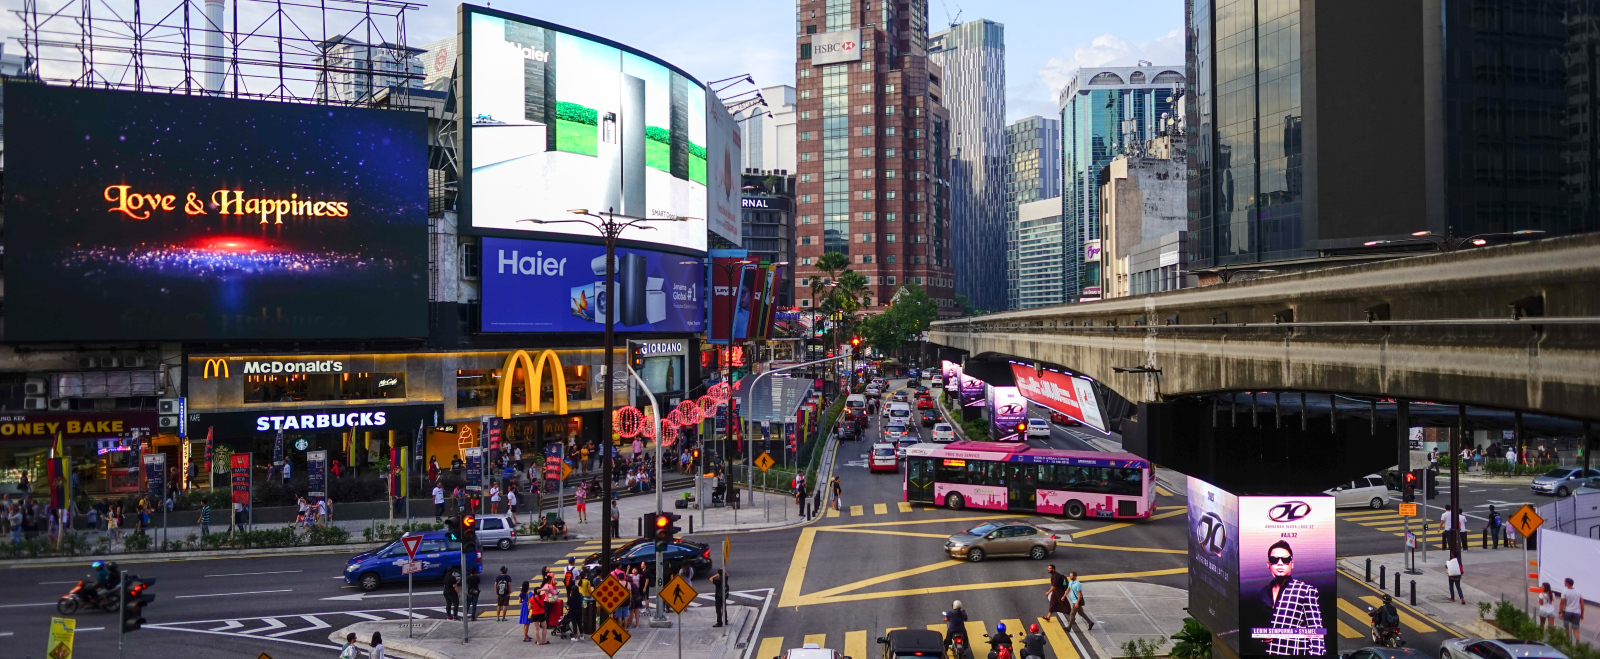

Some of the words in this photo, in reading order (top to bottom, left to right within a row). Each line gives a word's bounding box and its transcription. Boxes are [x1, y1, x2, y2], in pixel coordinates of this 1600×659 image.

[510, 41, 549, 63] aier
[814, 43, 840, 54] HSBC
[104, 185, 176, 220] Love
[184, 192, 207, 215] &
[211, 190, 348, 224] Happiness
[742, 198, 768, 208] RNAL
[498, 250, 567, 276] Haier
[673, 292, 686, 300] Global
[687, 283, 696, 302] #1
[641, 342, 682, 354] GIORDANO
[244, 360, 343, 374] McDonald's
[0, 422, 60, 435] ONEY
[67, 421, 124, 433] BAKE
[256, 412, 386, 431] STARBUCKS
